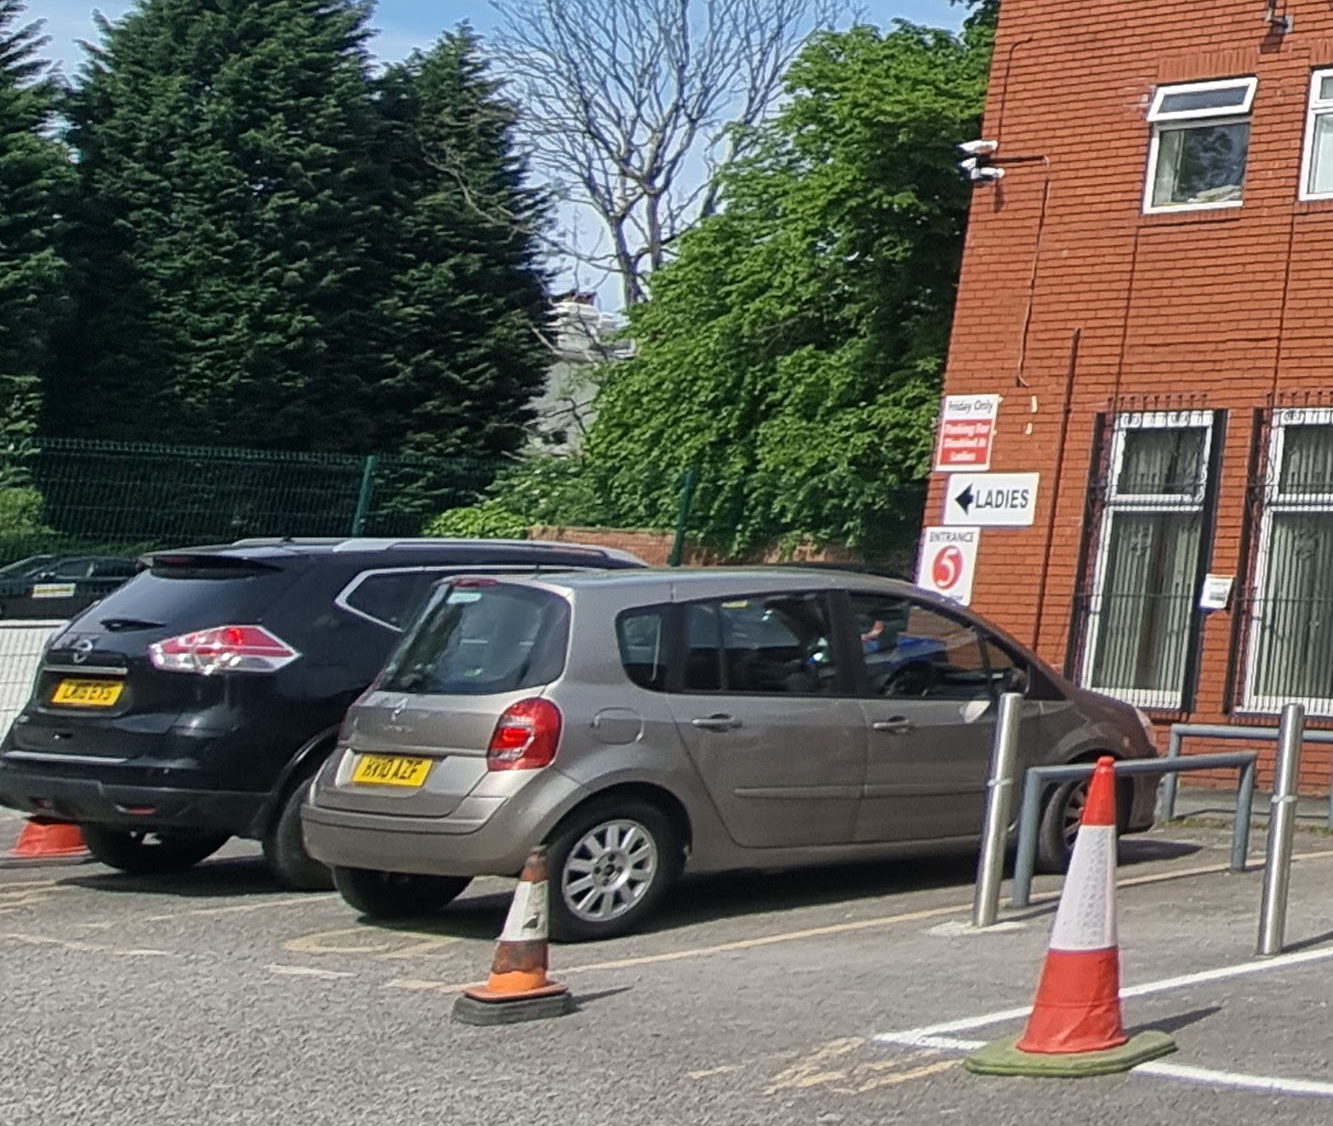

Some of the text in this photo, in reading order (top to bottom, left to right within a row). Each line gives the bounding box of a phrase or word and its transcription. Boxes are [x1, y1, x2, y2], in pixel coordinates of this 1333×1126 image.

[975, 489, 1029, 509] LADIES
[929, 531, 975, 542] ENTRANCE
[936, 548, 959, 586] 5
